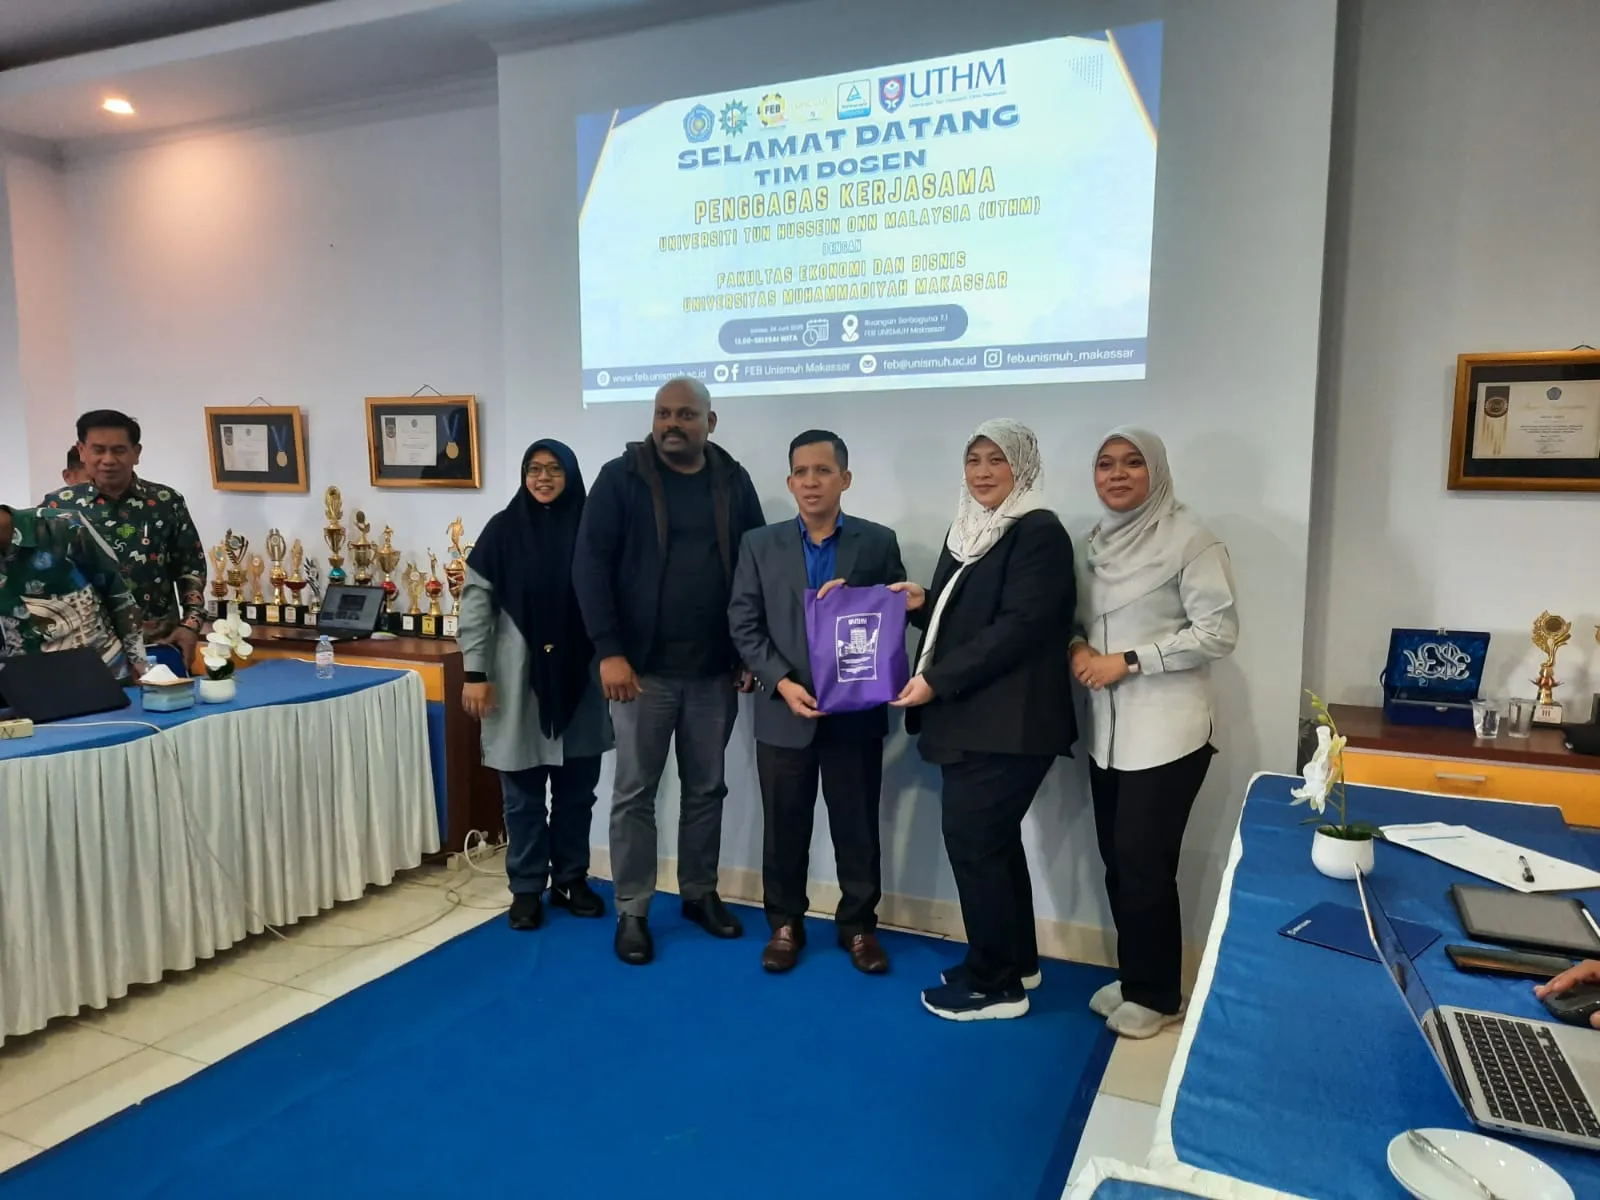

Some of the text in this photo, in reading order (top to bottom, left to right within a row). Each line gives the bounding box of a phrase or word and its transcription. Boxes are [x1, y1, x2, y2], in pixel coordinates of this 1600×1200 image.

[910, 58, 1006, 98] UTHM
[678, 104, 1020, 170] SELAMAT DATANG
[754, 149, 927, 187] TIM DOSEN
[694, 166, 996, 224] PENGGAGAS KERJASAMA
[658, 196, 1041, 252] UNIVERSITI TUN HUSSEIN ONN MALAYSIA (UTHM)
[822, 240, 862, 256] DENGAN
[716, 251, 967, 290] FAKULTAS EKONOMI DAN BISNIS
[683, 271, 1008, 313] UNIVERSITAS MUHAMMADIYAH MAKASSAR
[744, 362, 850, 376] FEB Unismuh Makassar
[883, 354, 977, 371] feb@unismuh.ac.id
[1007, 348, 1136, 364] feb.unismuh_makassar
